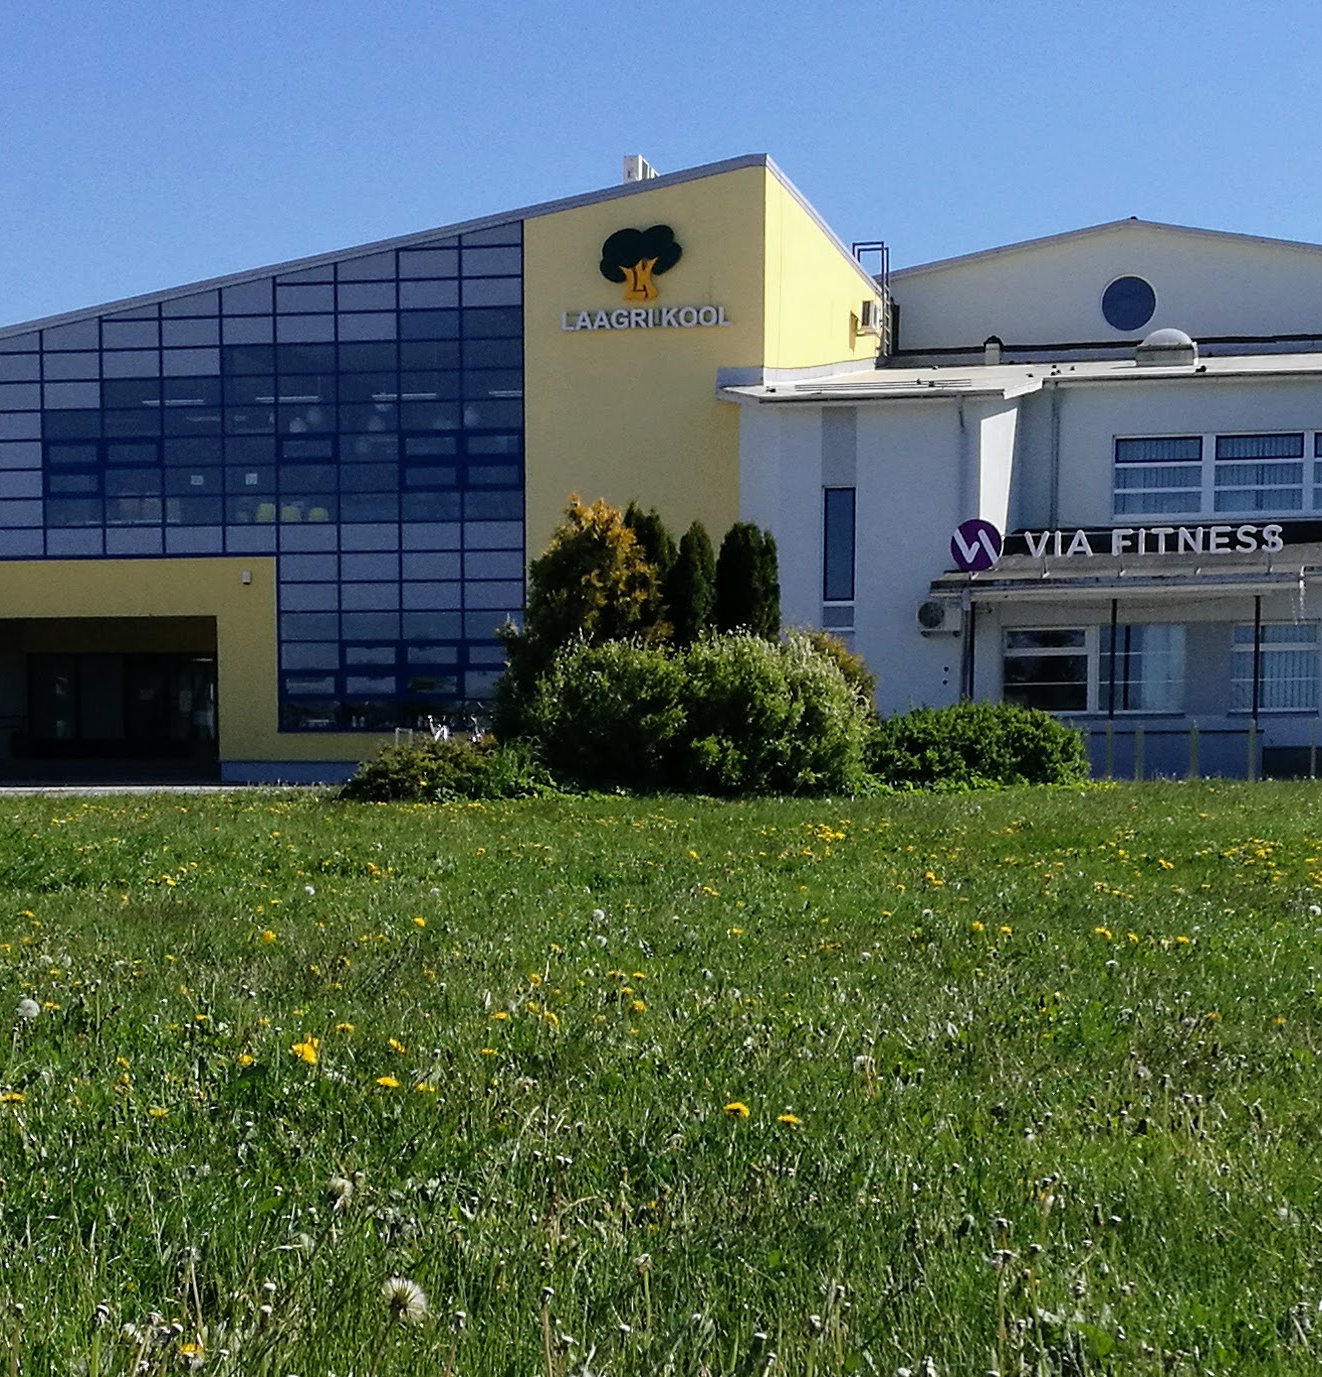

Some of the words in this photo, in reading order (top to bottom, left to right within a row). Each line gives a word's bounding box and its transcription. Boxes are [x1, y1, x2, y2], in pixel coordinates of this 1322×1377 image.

[562, 308, 654, 331] LAAGRI
[661, 306, 732, 329] KOOL
[1024, 530, 1094, 558] VIA
[1111, 524, 1284, 557] FITNESS
